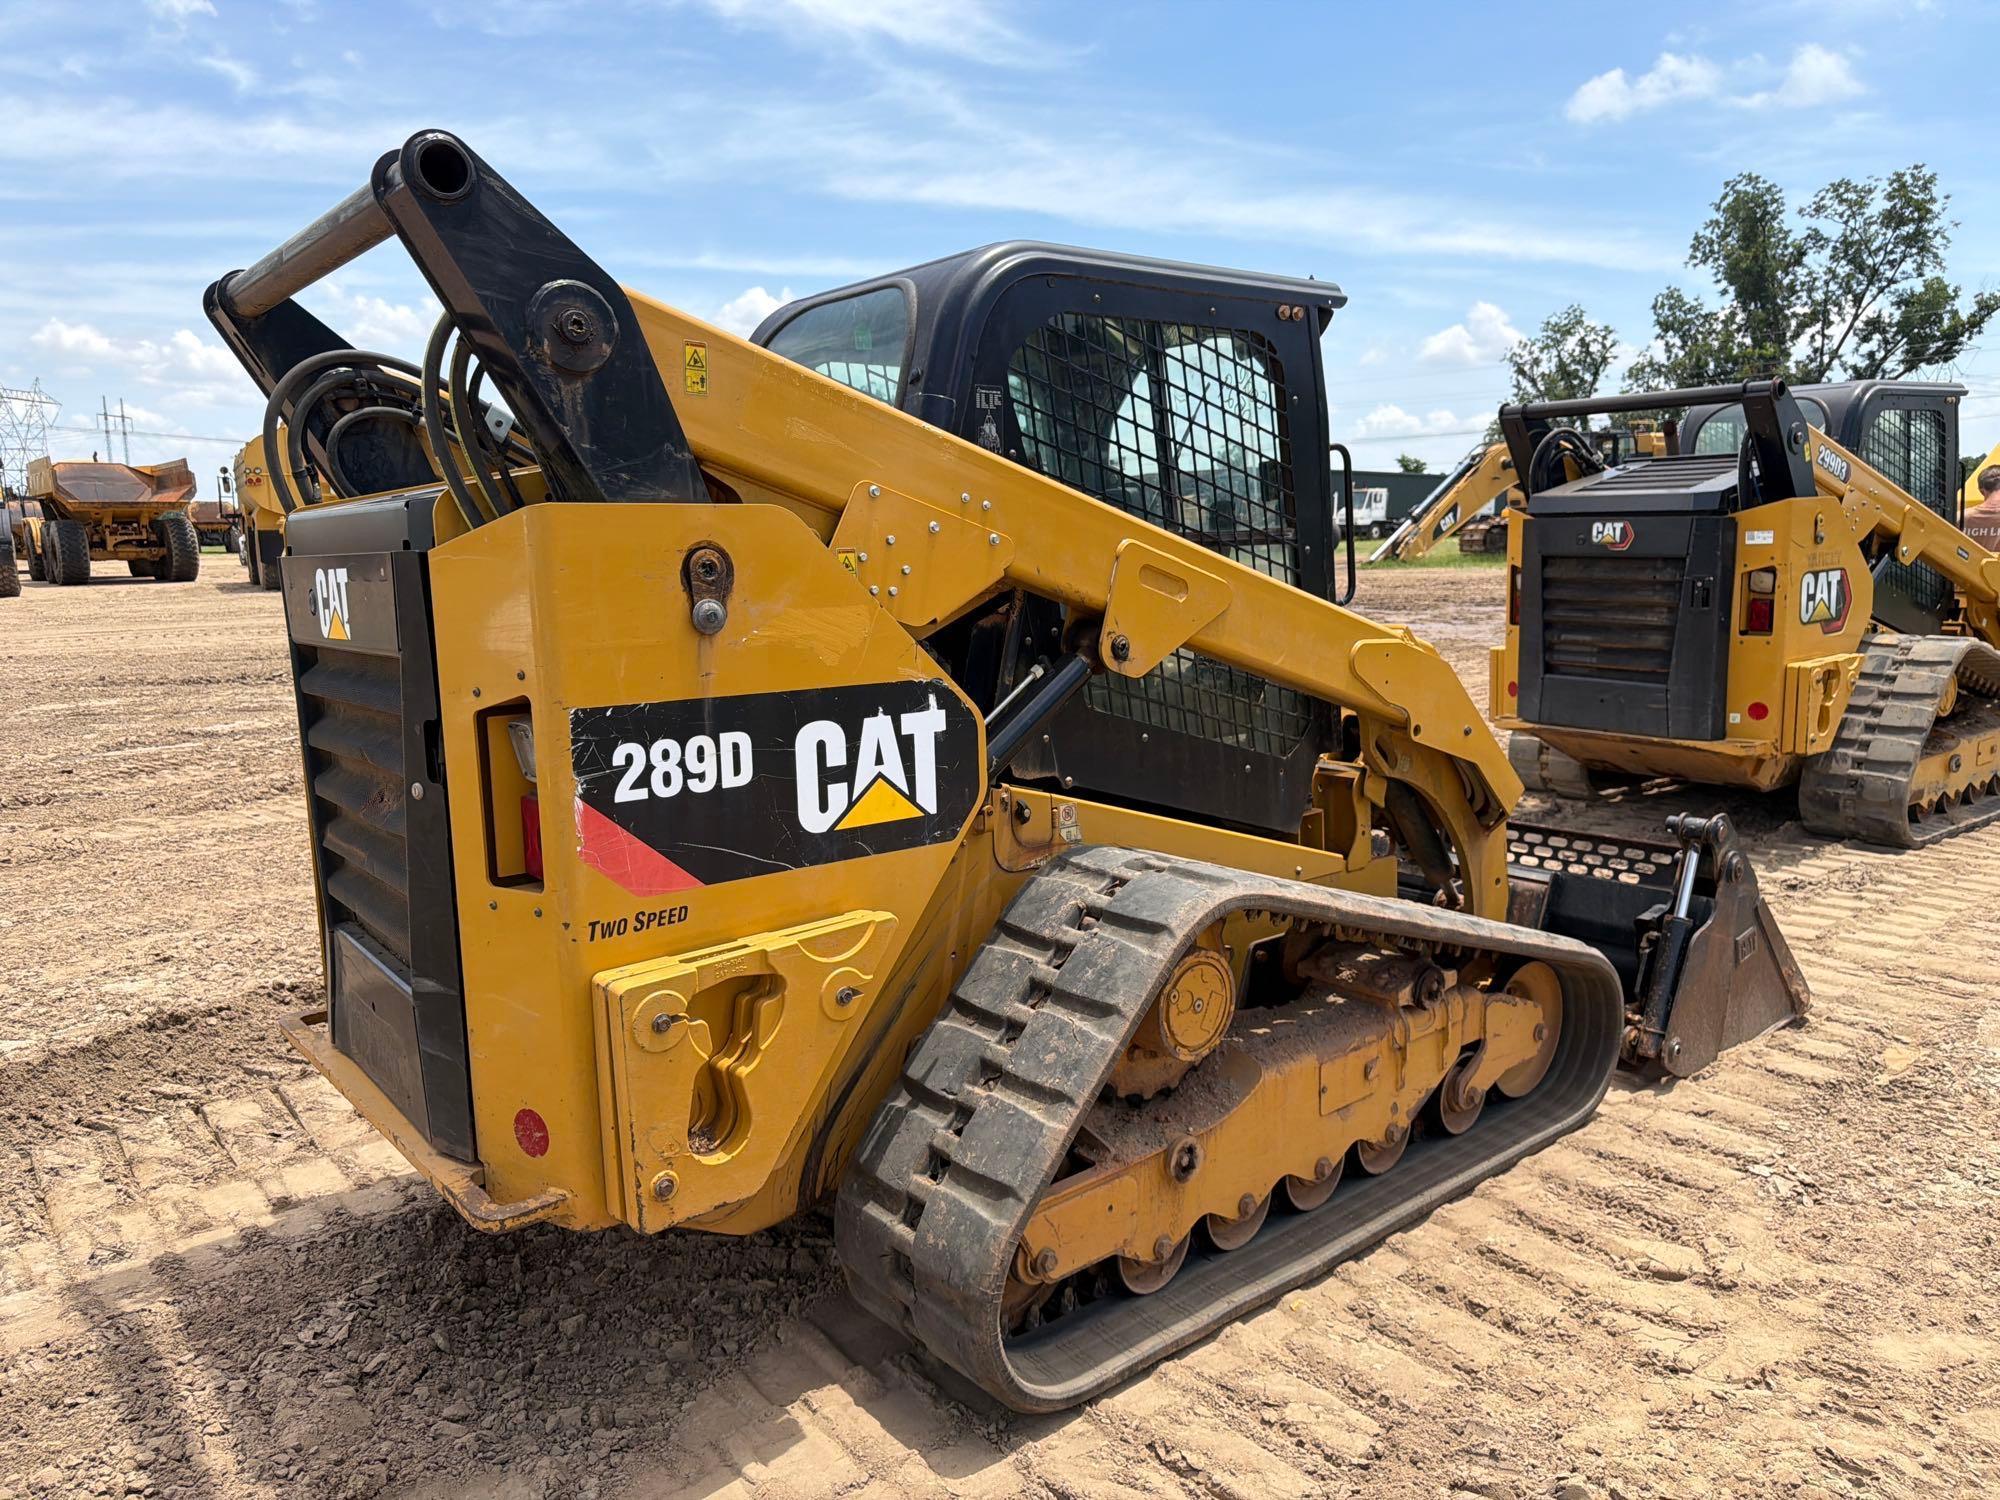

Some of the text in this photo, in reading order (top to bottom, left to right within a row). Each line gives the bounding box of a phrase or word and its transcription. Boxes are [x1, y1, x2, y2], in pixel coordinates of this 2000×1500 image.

[1592, 522, 1623, 543] CAT
[316, 567, 351, 640] CAT
[1801, 570, 1841, 624] CAT
[612, 708, 946, 834] 289D CAT
